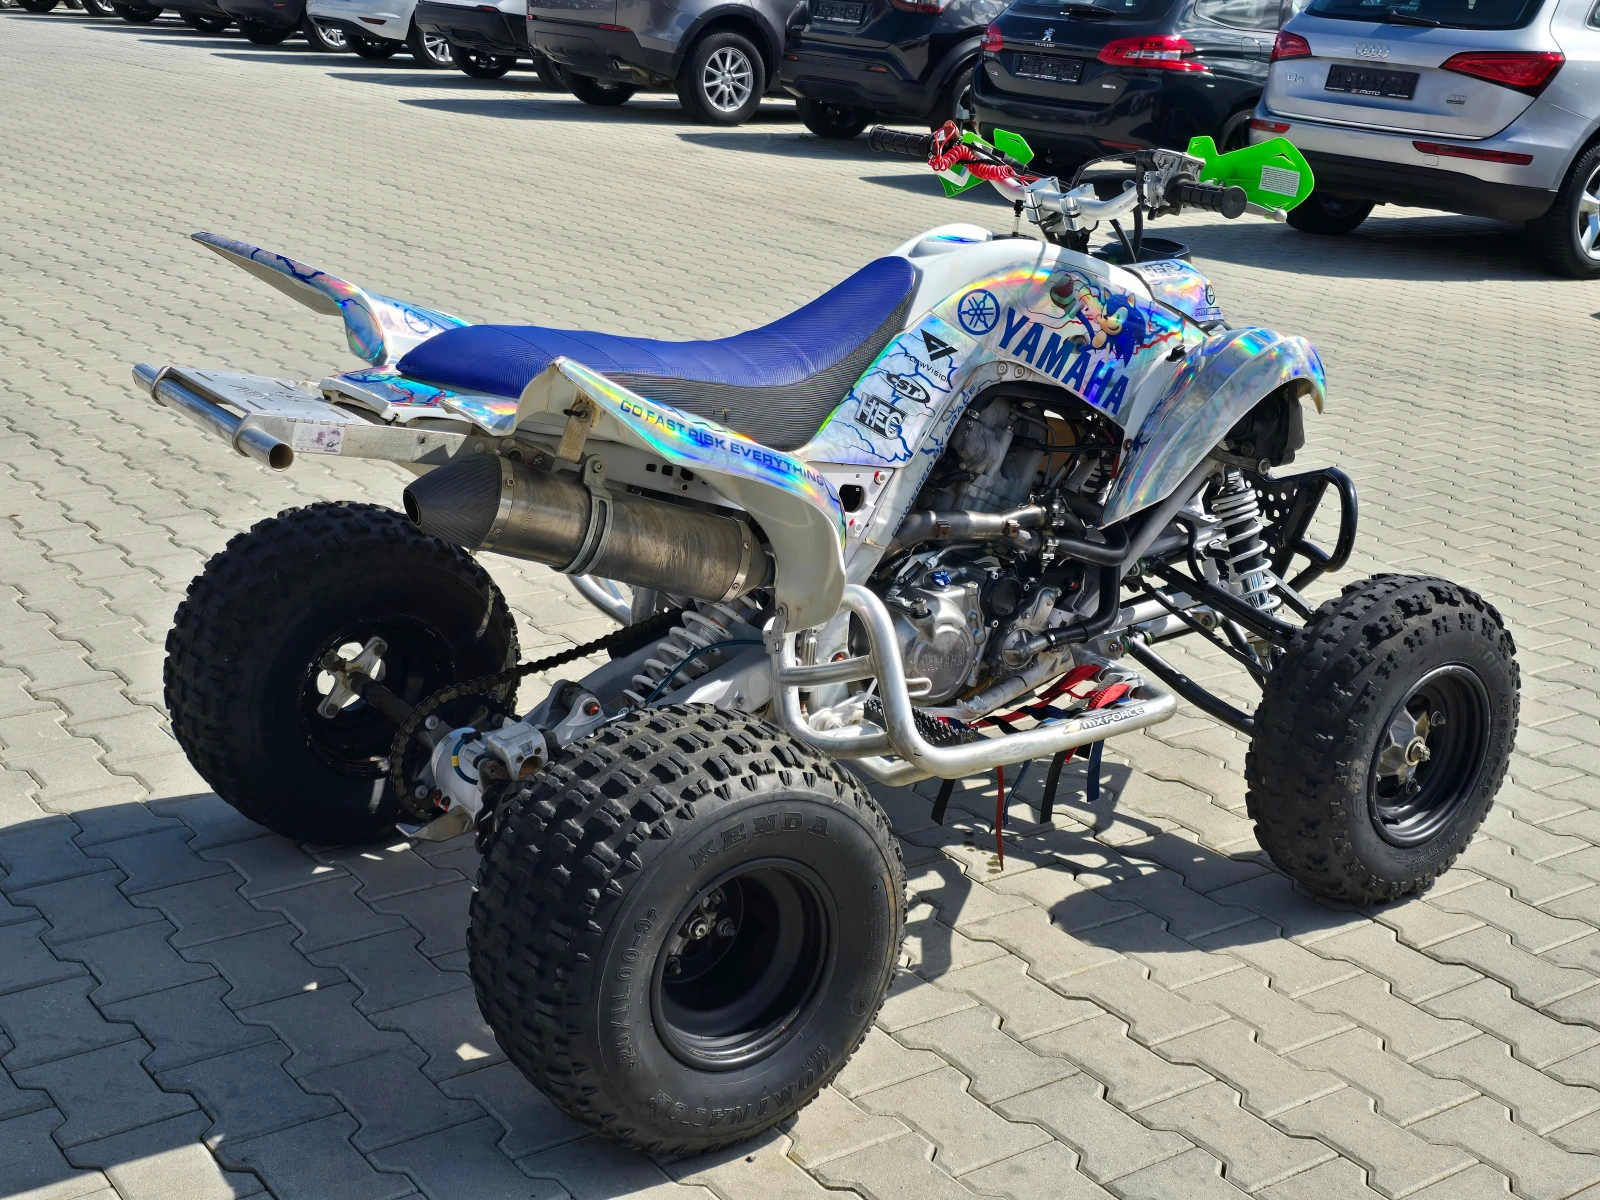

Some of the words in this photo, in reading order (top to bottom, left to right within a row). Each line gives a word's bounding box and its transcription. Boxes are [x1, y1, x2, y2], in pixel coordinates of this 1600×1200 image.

[886, 374, 921, 396] CST
[999, 307, 1129, 415] YAMAHA
[620, 400, 642, 417] GO
[646, 410, 690, 434] FAST
[730, 443, 825, 487] EVERYTHING
[945, 384, 976, 437] GRACE
[688, 812, 829, 871] KENDA
[648, 1050, 832, 1129] DOMINATOR
